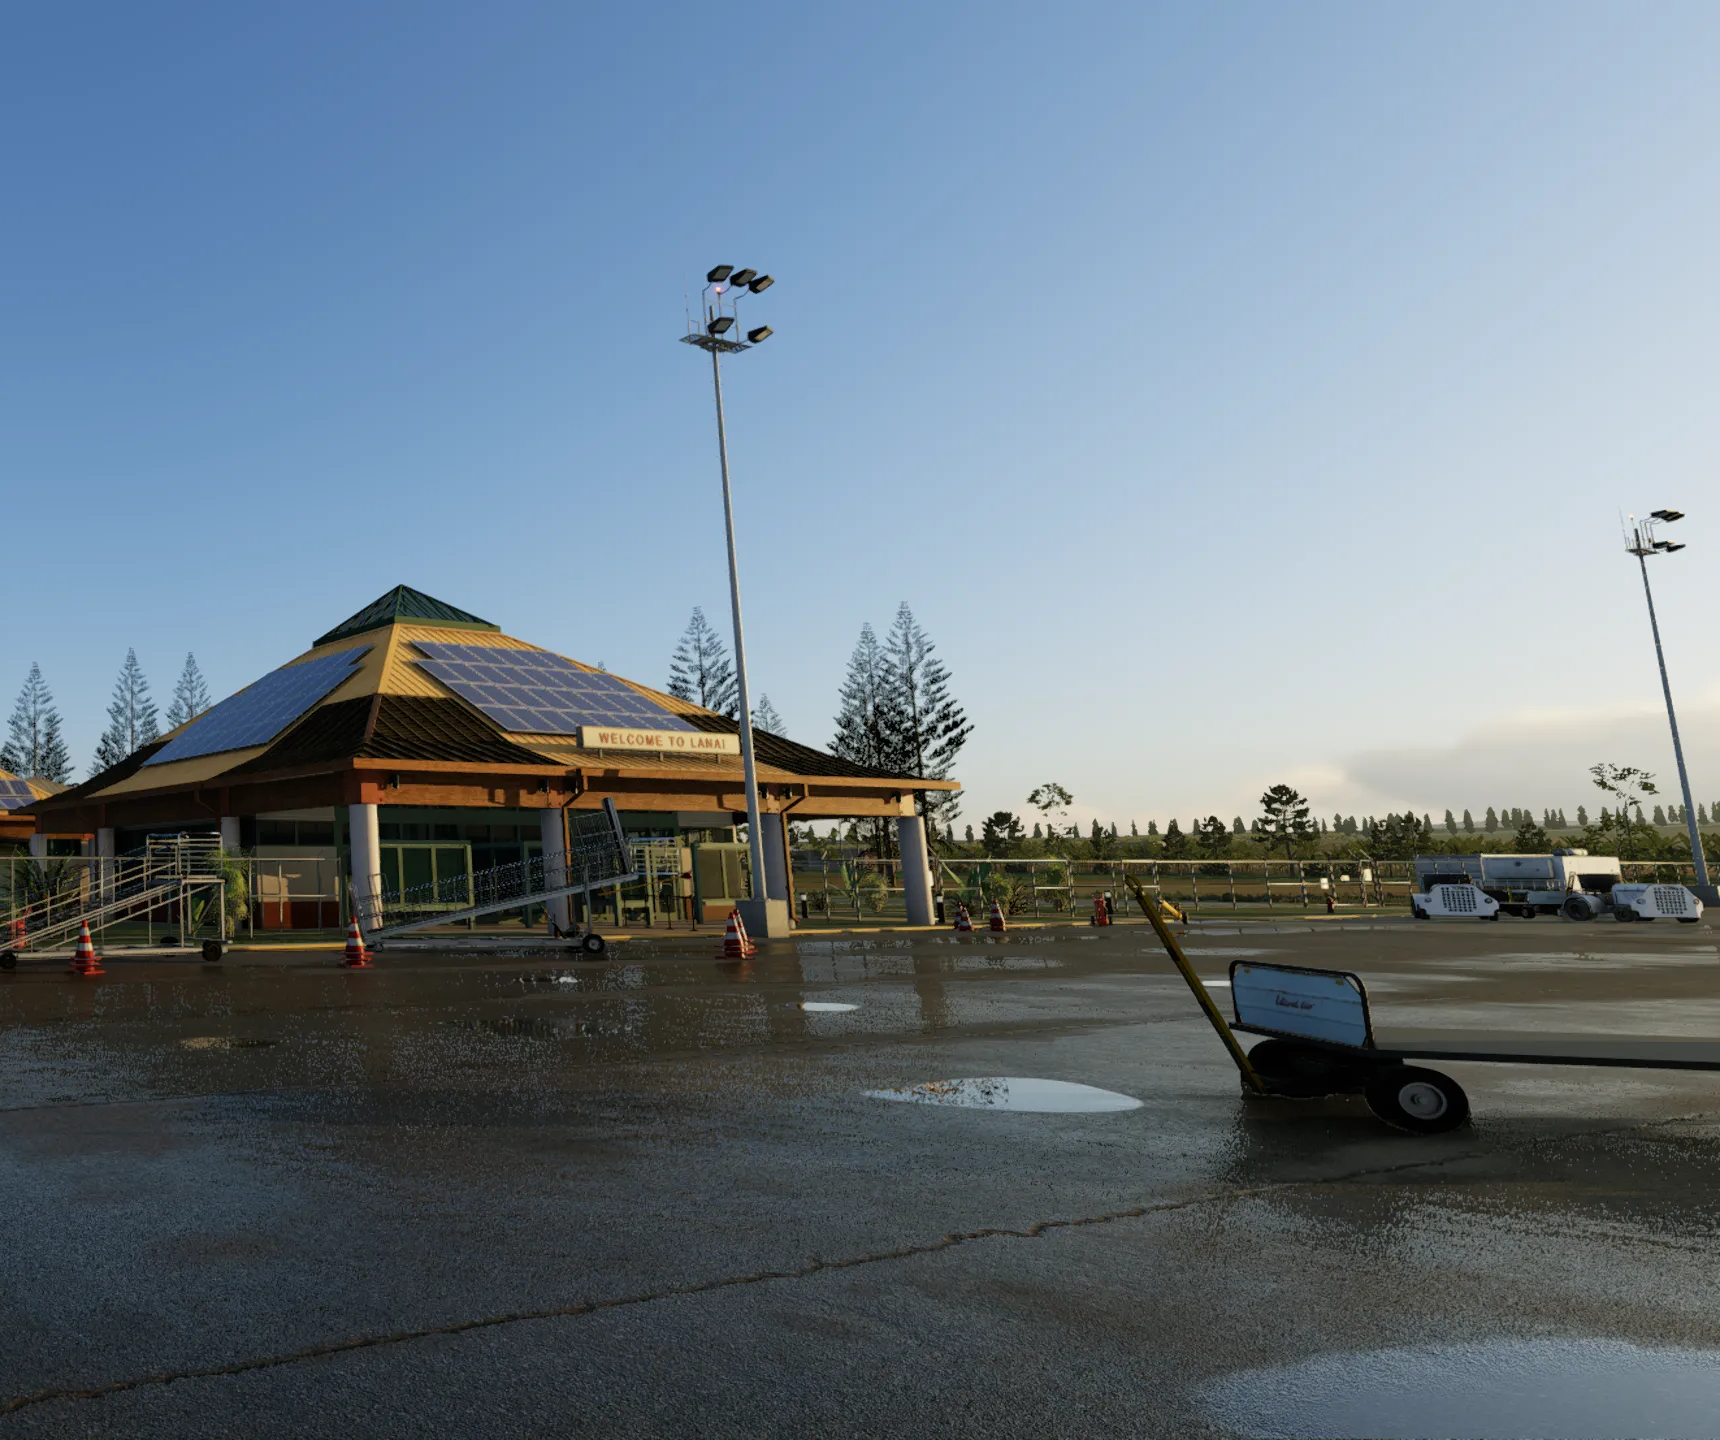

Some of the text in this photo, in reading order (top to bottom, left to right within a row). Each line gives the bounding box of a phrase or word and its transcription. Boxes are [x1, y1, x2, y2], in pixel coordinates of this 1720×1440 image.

[598, 732, 726, 749] WELCOME TO LANAI
